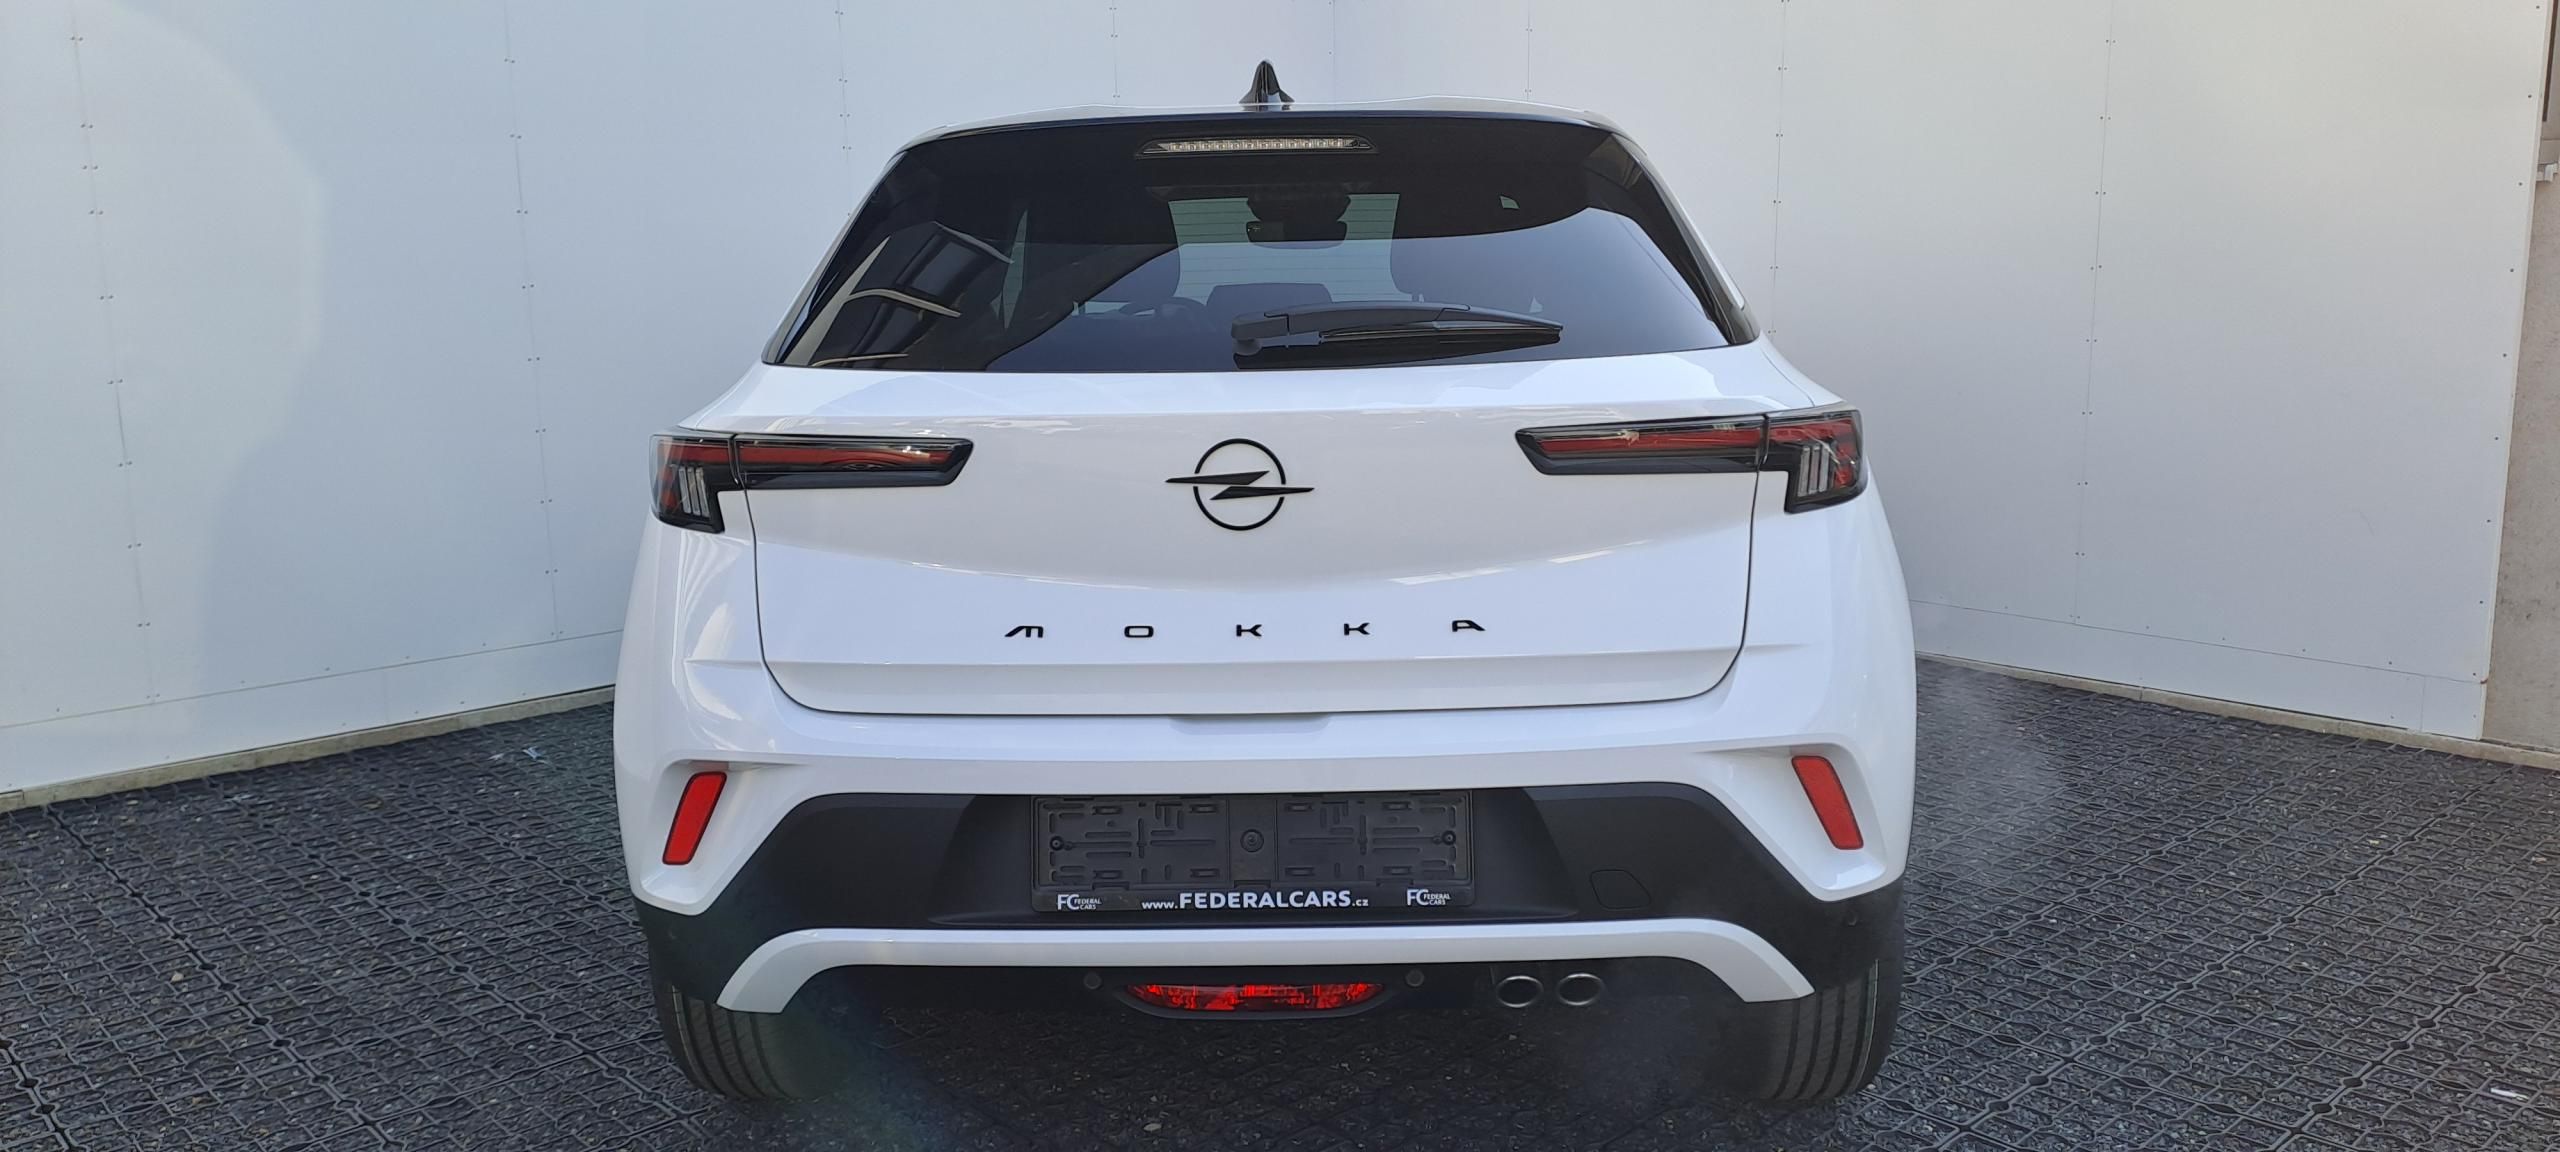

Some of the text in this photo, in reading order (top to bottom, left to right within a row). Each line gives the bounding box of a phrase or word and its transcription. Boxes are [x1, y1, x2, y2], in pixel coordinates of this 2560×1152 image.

[1004, 619, 1486, 639] MOKKA
[1057, 893, 1080, 910] FC
[1141, 890, 1369, 910] www.FEDERALCARS.cz
[1407, 888, 1429, 906] FC
